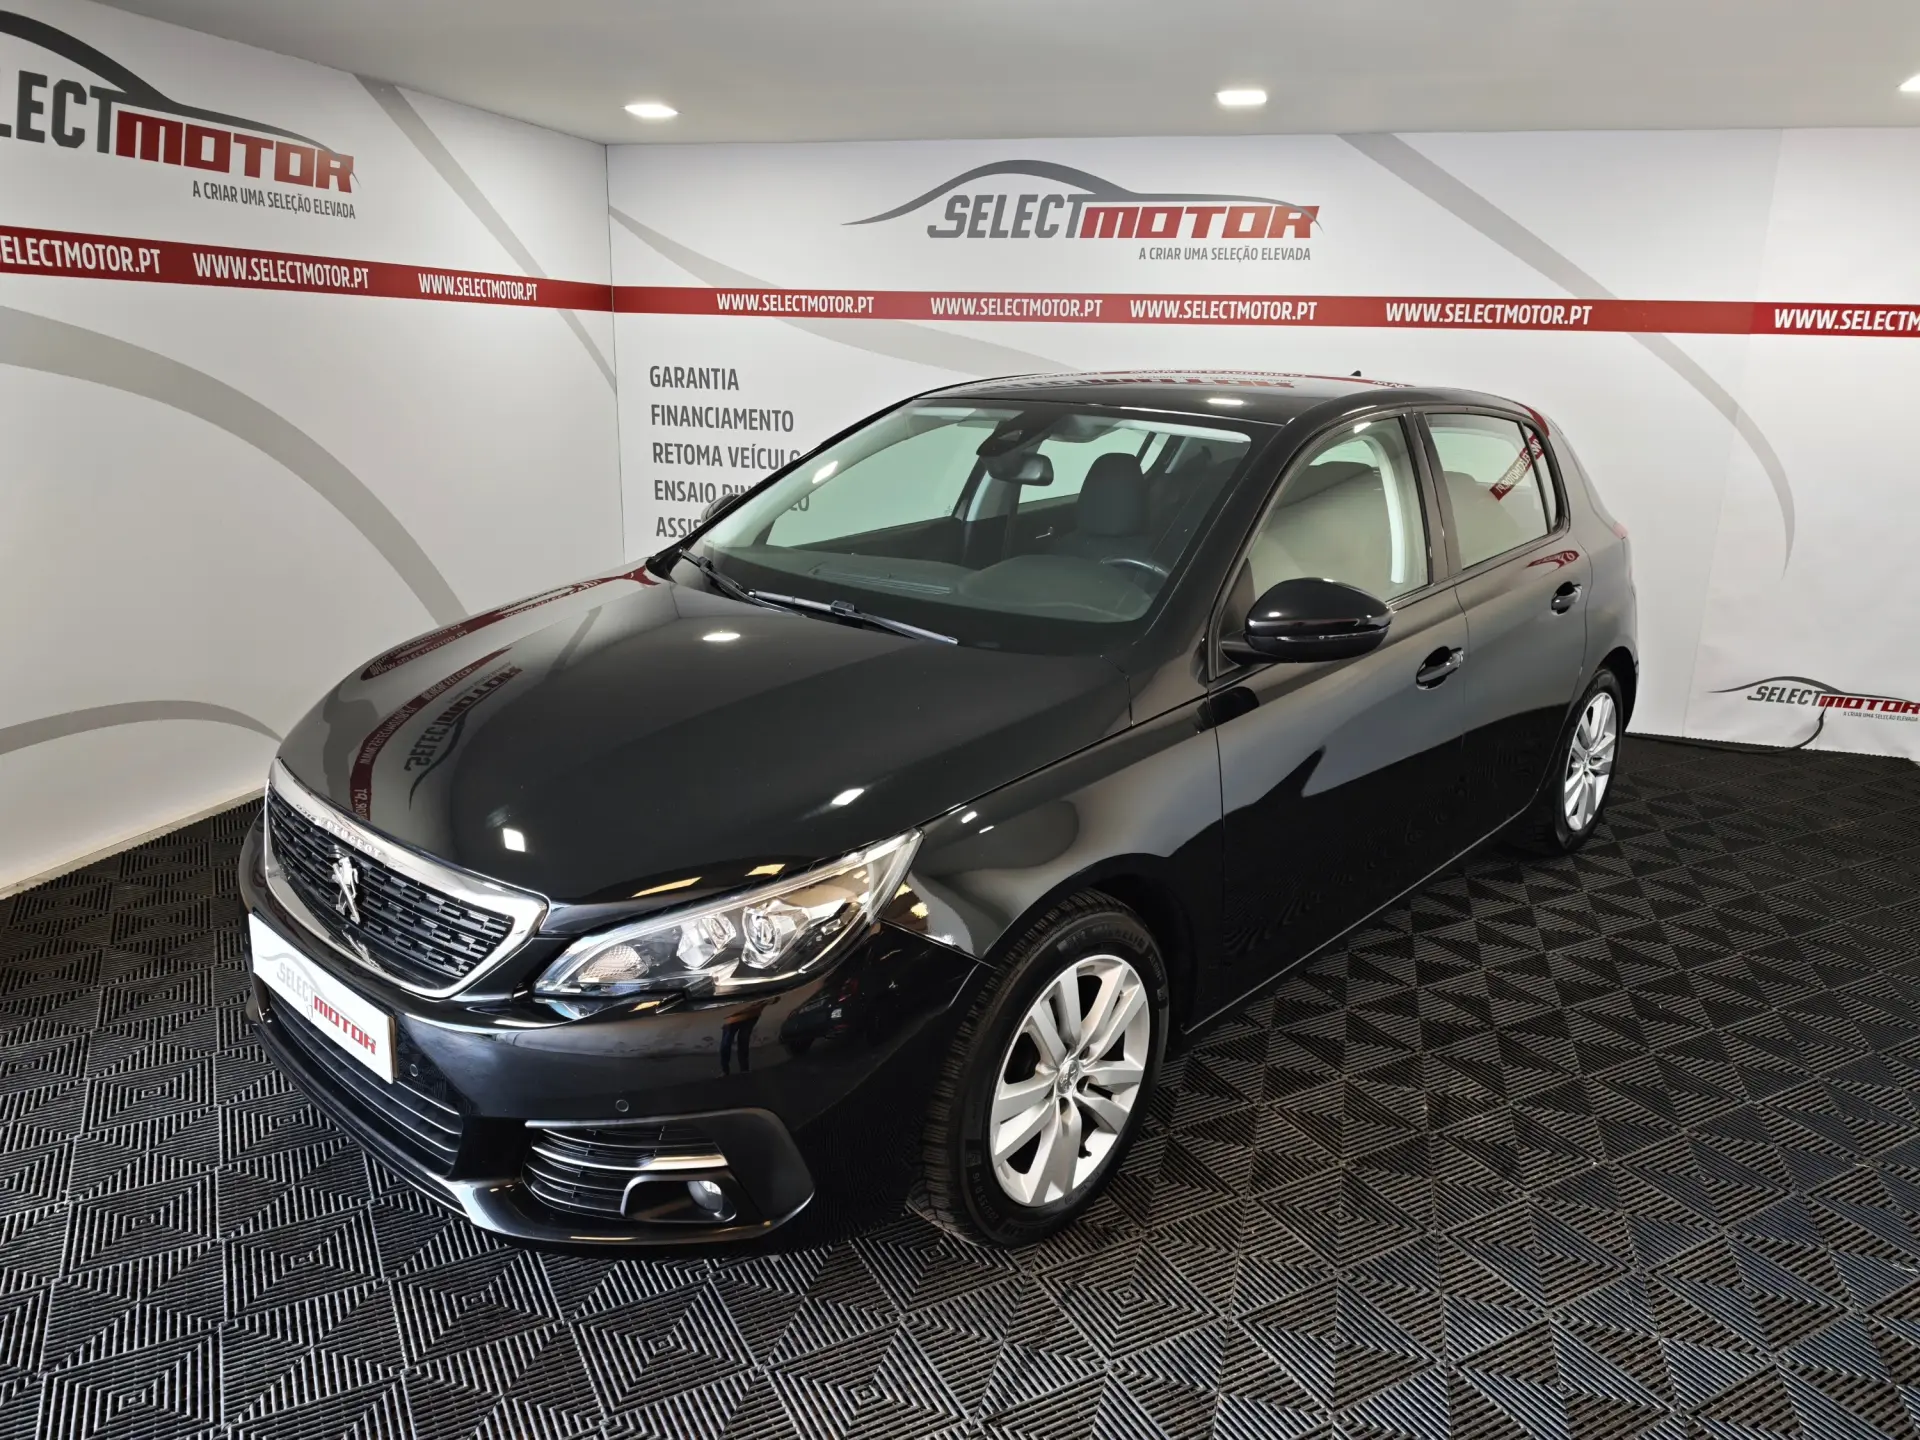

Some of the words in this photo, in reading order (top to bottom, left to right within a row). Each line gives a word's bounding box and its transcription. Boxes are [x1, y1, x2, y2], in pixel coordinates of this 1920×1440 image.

[193, 180, 201, 197] A
[203, 182, 238, 204] CRIAR
[240, 188, 266, 207] UMA
[268, 191, 311, 214] SELEÇÃO
[314, 199, 356, 219] ELEVADA
[927, 194, 1319, 238] SELECTMOTOR
[0, 235, 160, 274] ELECTMOTOR.PT
[1139, 247, 1146, 260] A
[1149, 247, 1181, 260] CRIAR
[1184, 247, 1208, 260] UMA
[1211, 245, 1259, 262] SELEÇÃO
[1261, 247, 1311, 260] ELEVADA
[193, 252, 369, 289] WWW.SELECTMOTOR.PT
[418, 273, 538, 301] WWW.SELECTMOTOR.PT
[716, 293, 875, 314] WWW.SELECTMOTOR.PT
[930, 297, 1103, 318] WWW.SELECTMOTOR.PT
[1130, 300, 1317, 321] WWW.SELECTMOTOR.PT
[1385, 302, 1593, 326] WWW.SELECTMOTOR.PT
[1774, 308, 1920, 331] WWW.SELECTM
[650, 366, 740, 391] GARANTIA
[651, 404, 794, 432] FINANCIAMENTO
[652, 442, 723, 467] RETOMA
[654, 480, 717, 504] ENSAIO
[1747, 686, 1920, 714] SELECTMOTOR
[326, 820, 380, 857] PEUGEOT
